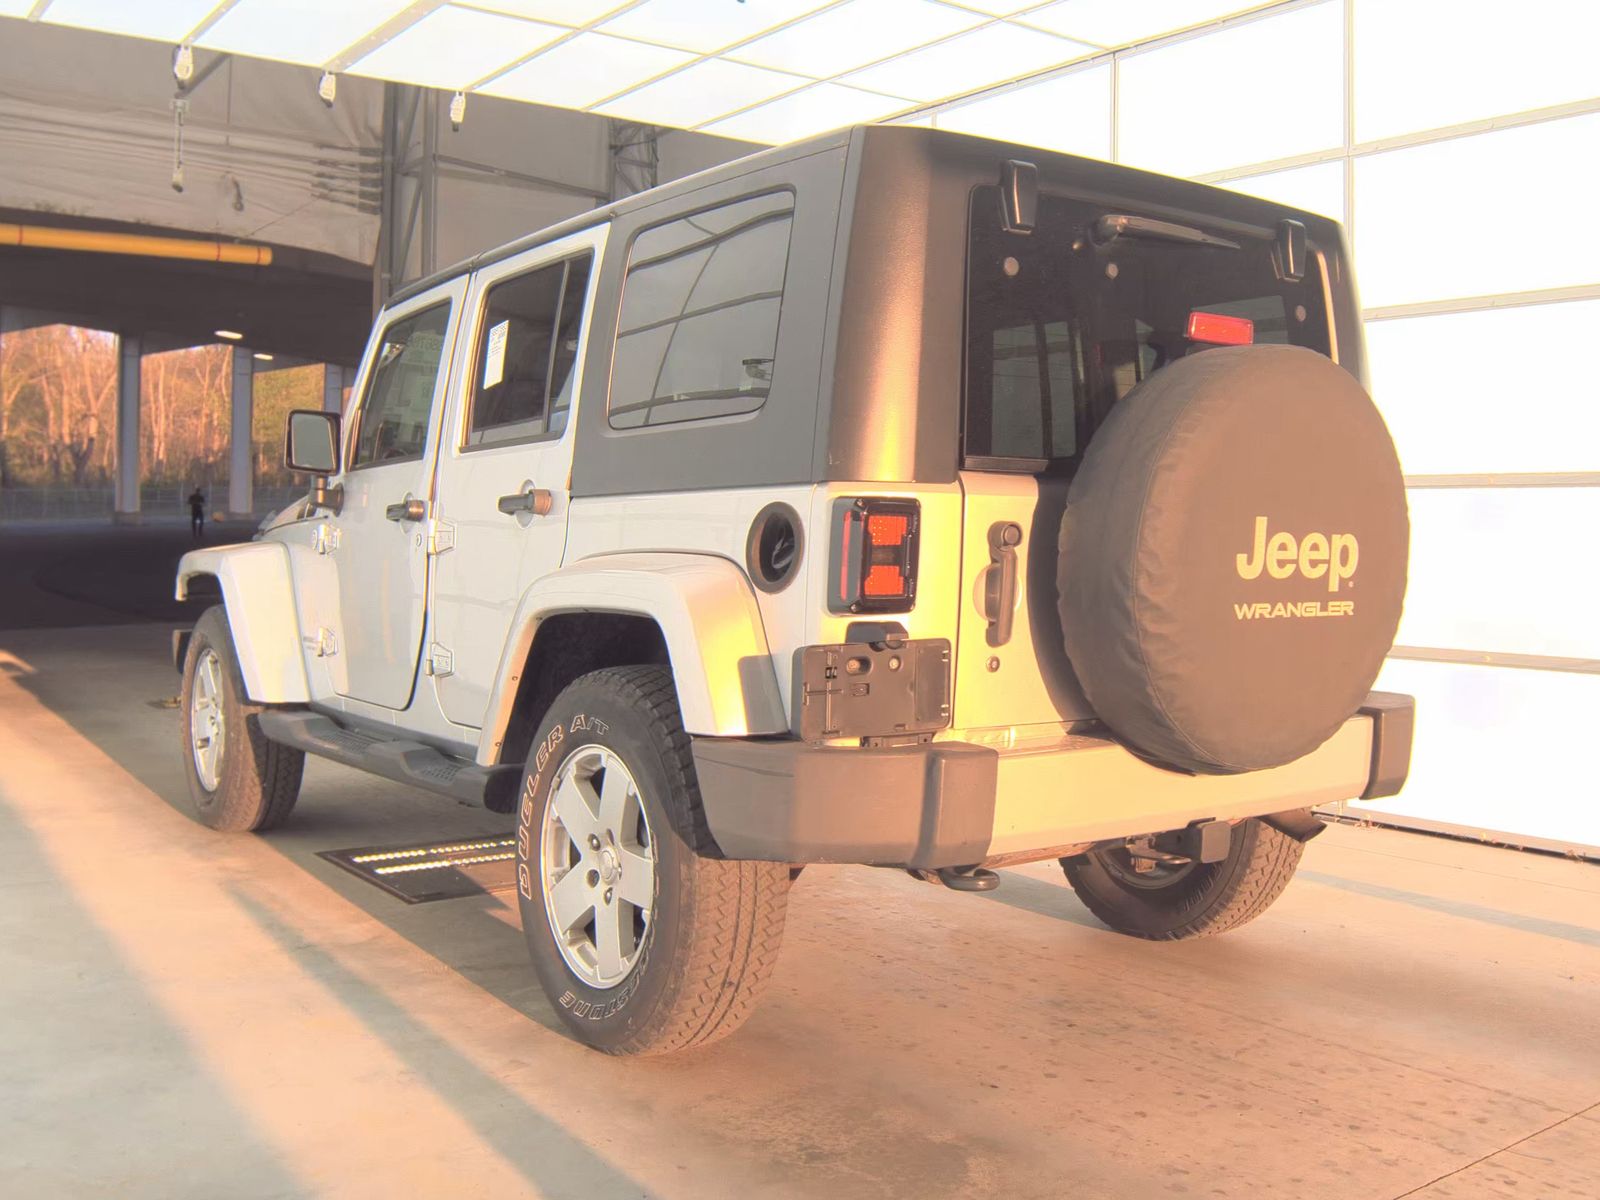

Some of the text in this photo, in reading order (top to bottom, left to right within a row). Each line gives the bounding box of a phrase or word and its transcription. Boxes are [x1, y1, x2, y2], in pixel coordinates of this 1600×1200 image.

[1236, 516, 1359, 592] Jeep
[1234, 601, 1355, 620] WRANGLER
[518, 714, 610, 900] DUELER A/T
